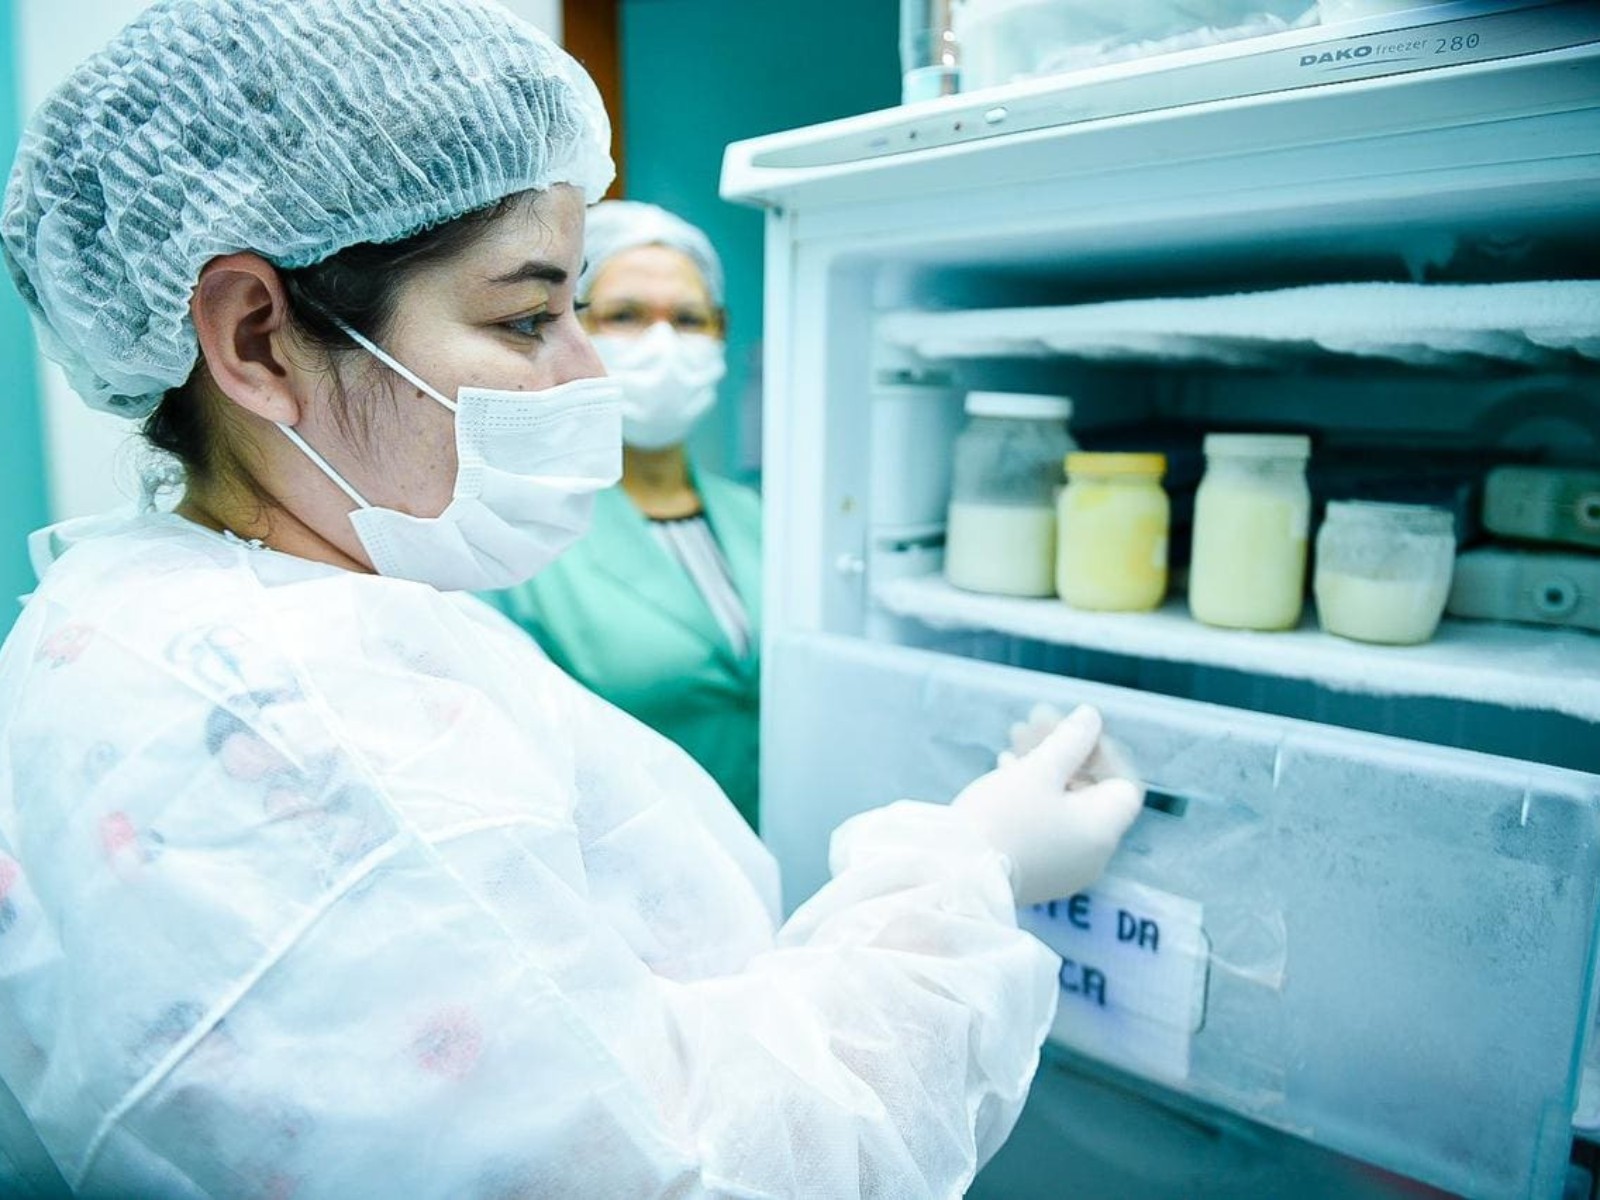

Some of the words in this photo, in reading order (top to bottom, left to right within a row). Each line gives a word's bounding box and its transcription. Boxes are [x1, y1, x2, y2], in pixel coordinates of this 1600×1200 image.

[1300, 45, 1372, 66] DAKO
[1375, 39, 1427, 56] freezer
[1435, 33, 1480, 54] 280
[1117, 909, 1159, 952] DA
